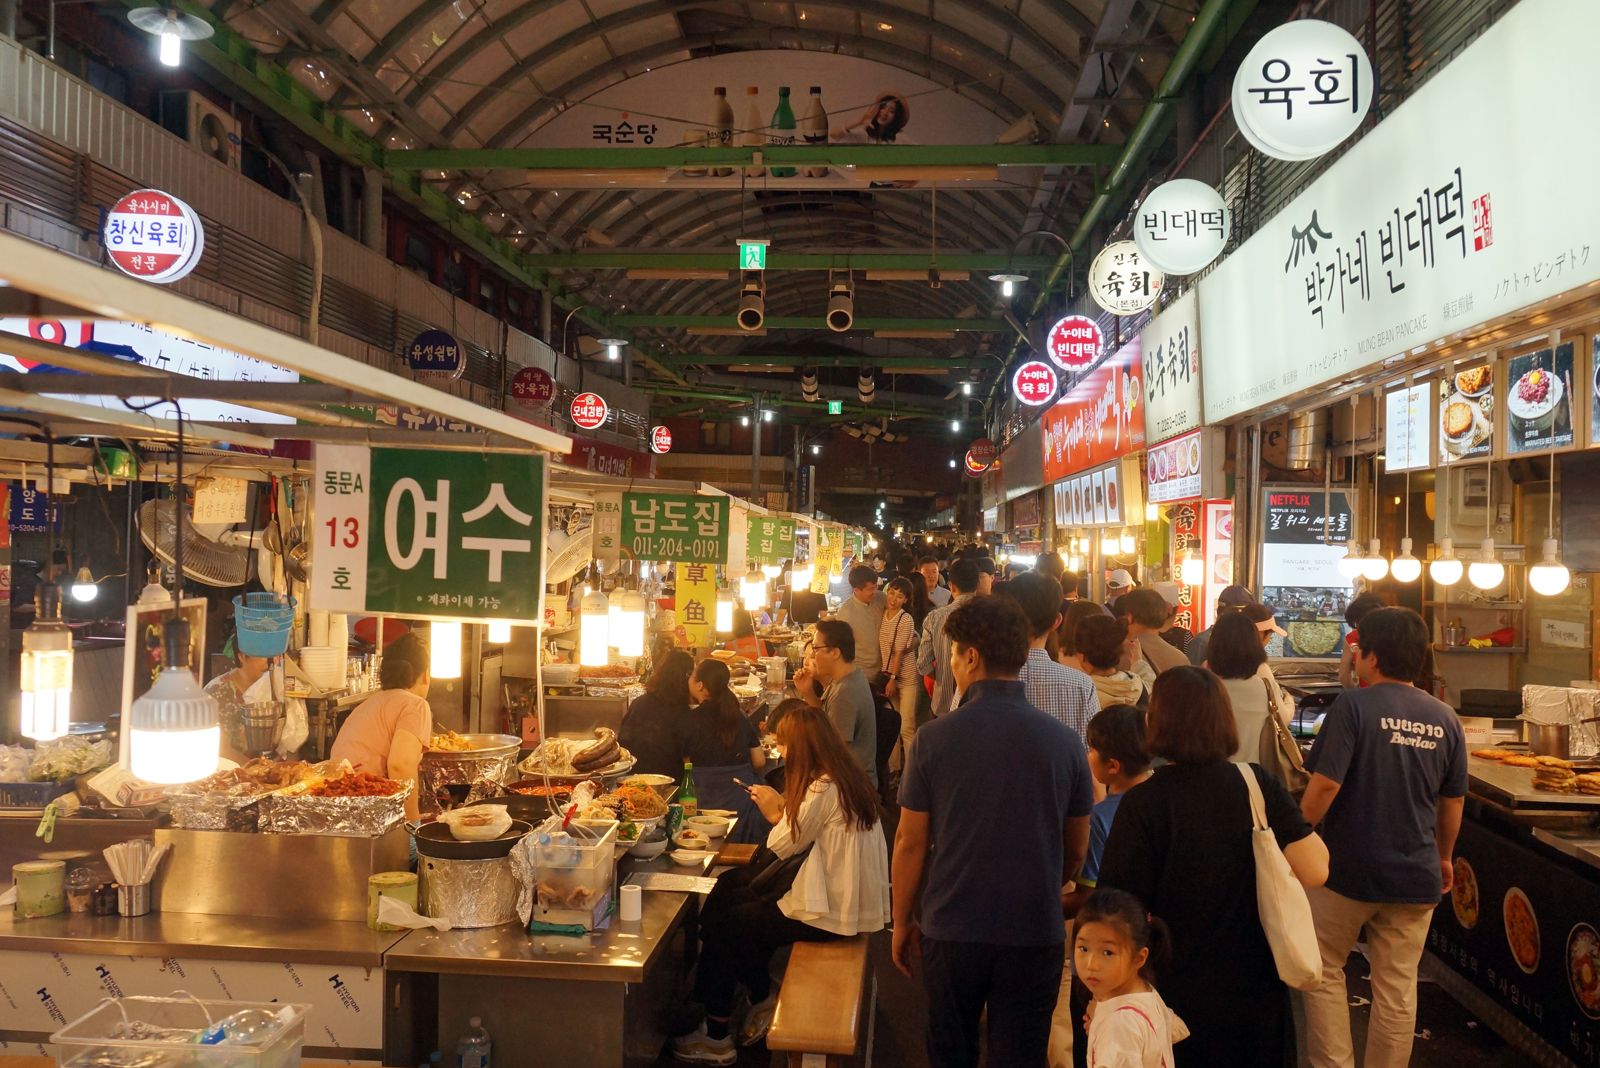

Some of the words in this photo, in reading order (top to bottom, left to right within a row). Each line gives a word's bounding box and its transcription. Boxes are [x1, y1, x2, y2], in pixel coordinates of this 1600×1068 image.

[1248, 54, 1359, 120] 육회
[592, 123, 658, 145] 국순당
[127, 199, 170, 214] 육사시미
[110, 219, 183, 248] 창신육회
[1143, 208, 1225, 241] 빈대떡
[1305, 230, 1370, 329] 박가네
[1378, 166, 1467, 294] 빈대떡
[130, 255, 157, 271] 전문
[1113, 253, 1139, 265] 진주
[1102, 271, 1150, 297] 육회
[1060, 327, 1093, 339] 누이네
[1357, 336, 1376, 354] MUNG
[1377, 328, 1395, 348] BEAN
[1395, 314, 1428, 340] PANCAKE
[411, 344, 457, 363] 유성쉼터
[1057, 342, 1096, 358] 빈대떡
[1145, 325, 1190, 403] 진주육회
[1022, 370, 1048, 380] 누이네
[514, 382, 550, 396] 정육점
[1021, 382, 1049, 394] 육회
[573, 405, 604, 418] 모녀김밥
[324, 471, 363, 495] 동문A
[596, 501, 620, 513] 동문A
[1270, 494, 1310, 506] NETFLIX
[629, 499, 720, 537] 남도집
[1270, 513, 1282, 531] 길
[1285, 514, 1310, 527] 위의
[325, 517, 360, 549] 13
[383, 476, 533, 583] 여수
[600, 536, 613, 548] 호
[633, 536, 720, 559] 011-204-0191
[331, 567, 351, 590] 호
[428, 593, 473, 608] 계좌이체
[478, 595, 501, 610] 가능
[1390, 731, 1437, 751] Beerlao
[336, 988, 350, 1009] STEEL
[341, 985, 360, 1013] HYUNDAI
[44, 1001, 58, 1021] STEEL
